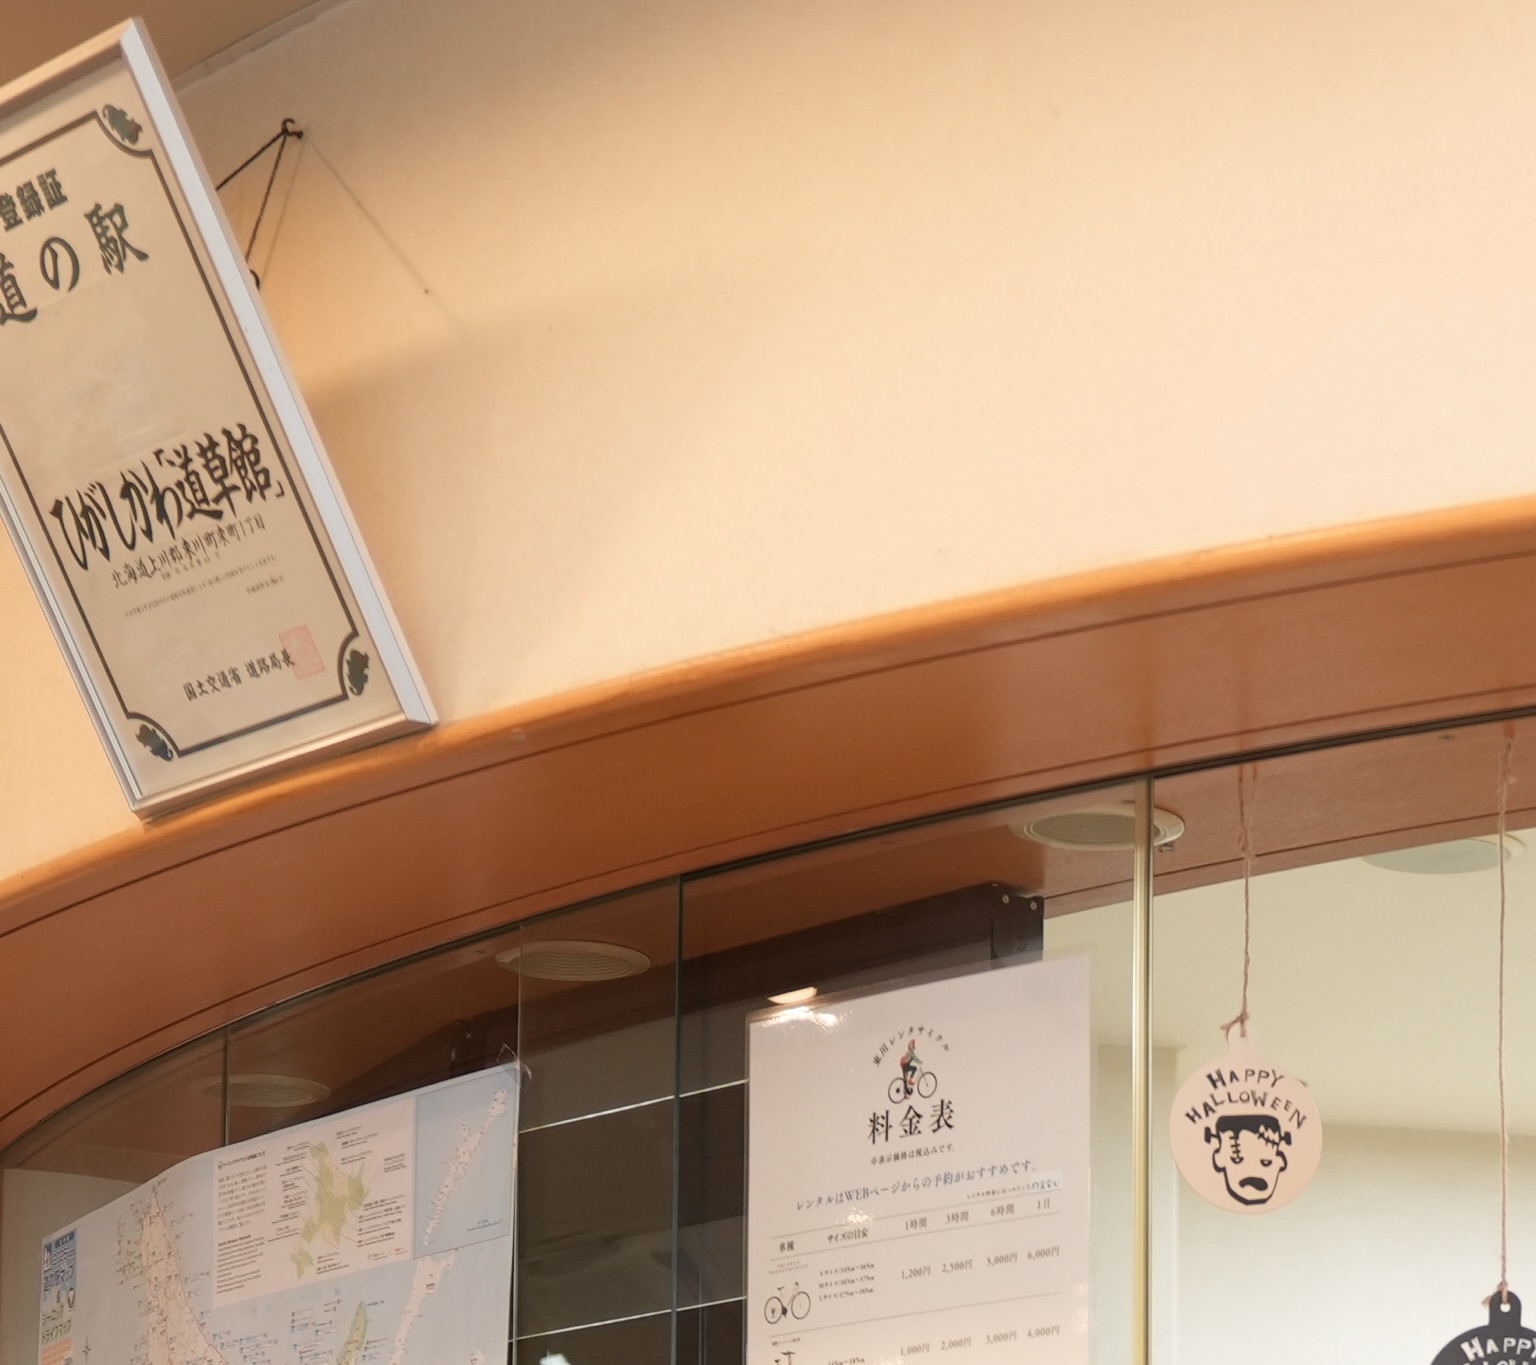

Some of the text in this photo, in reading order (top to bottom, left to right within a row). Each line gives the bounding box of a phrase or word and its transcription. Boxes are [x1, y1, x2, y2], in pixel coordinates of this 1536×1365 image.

[873, 1025, 950, 1067] 東川レンタサイクル
[1206, 1068, 1285, 1091] HAPPY
[867, 1099, 955, 1145] 料金表
[1185, 1090, 1307, 1130] HALLOWEEN
[796, 1159, 1037, 1212] レンタルはWEBページからの予約がおすすめです。
[905, 1217, 927, 1231] 1時間
[945, 1211, 969, 1225] 3時間
[990, 1204, 1015, 1218] 6時間
[901, 1245, 1060, 1280] 1,200円 2,500円 5,000円 6,000円
[901, 1343, 931, 1357] 1,000円
[941, 1337, 972, 1351] 2,000円
[985, 1330, 1018, 1345] 3,000円
[1027, 1324, 1060, 1339] 4,000円
